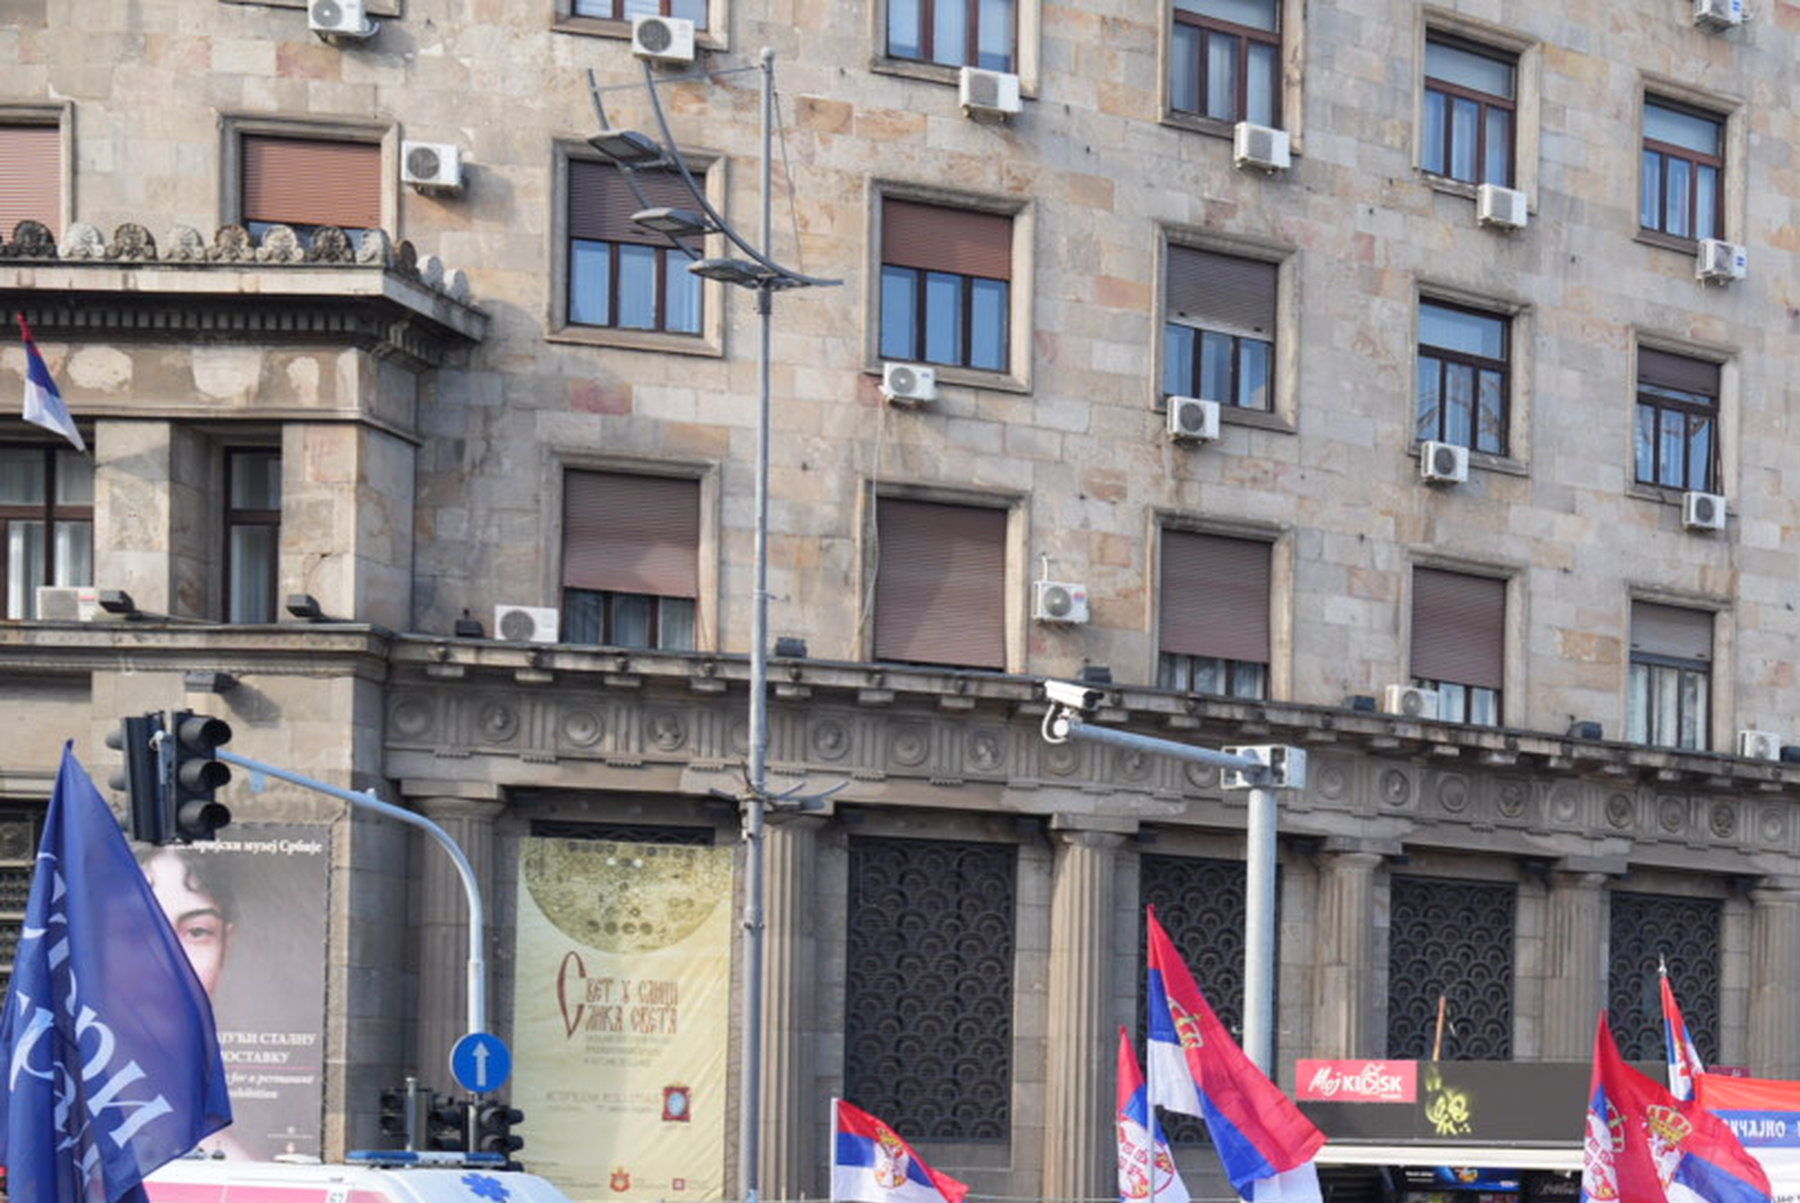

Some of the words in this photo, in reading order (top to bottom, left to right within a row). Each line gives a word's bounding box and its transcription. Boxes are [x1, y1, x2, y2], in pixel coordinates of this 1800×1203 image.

[260, 1033, 317, 1045] СТАЛНУ
[1308, 1066, 1342, 1097] Moj
[1342, 1074, 1403, 1093] KIOSK
[1728, 1118, 1786, 1138] ИЧАЈНО
